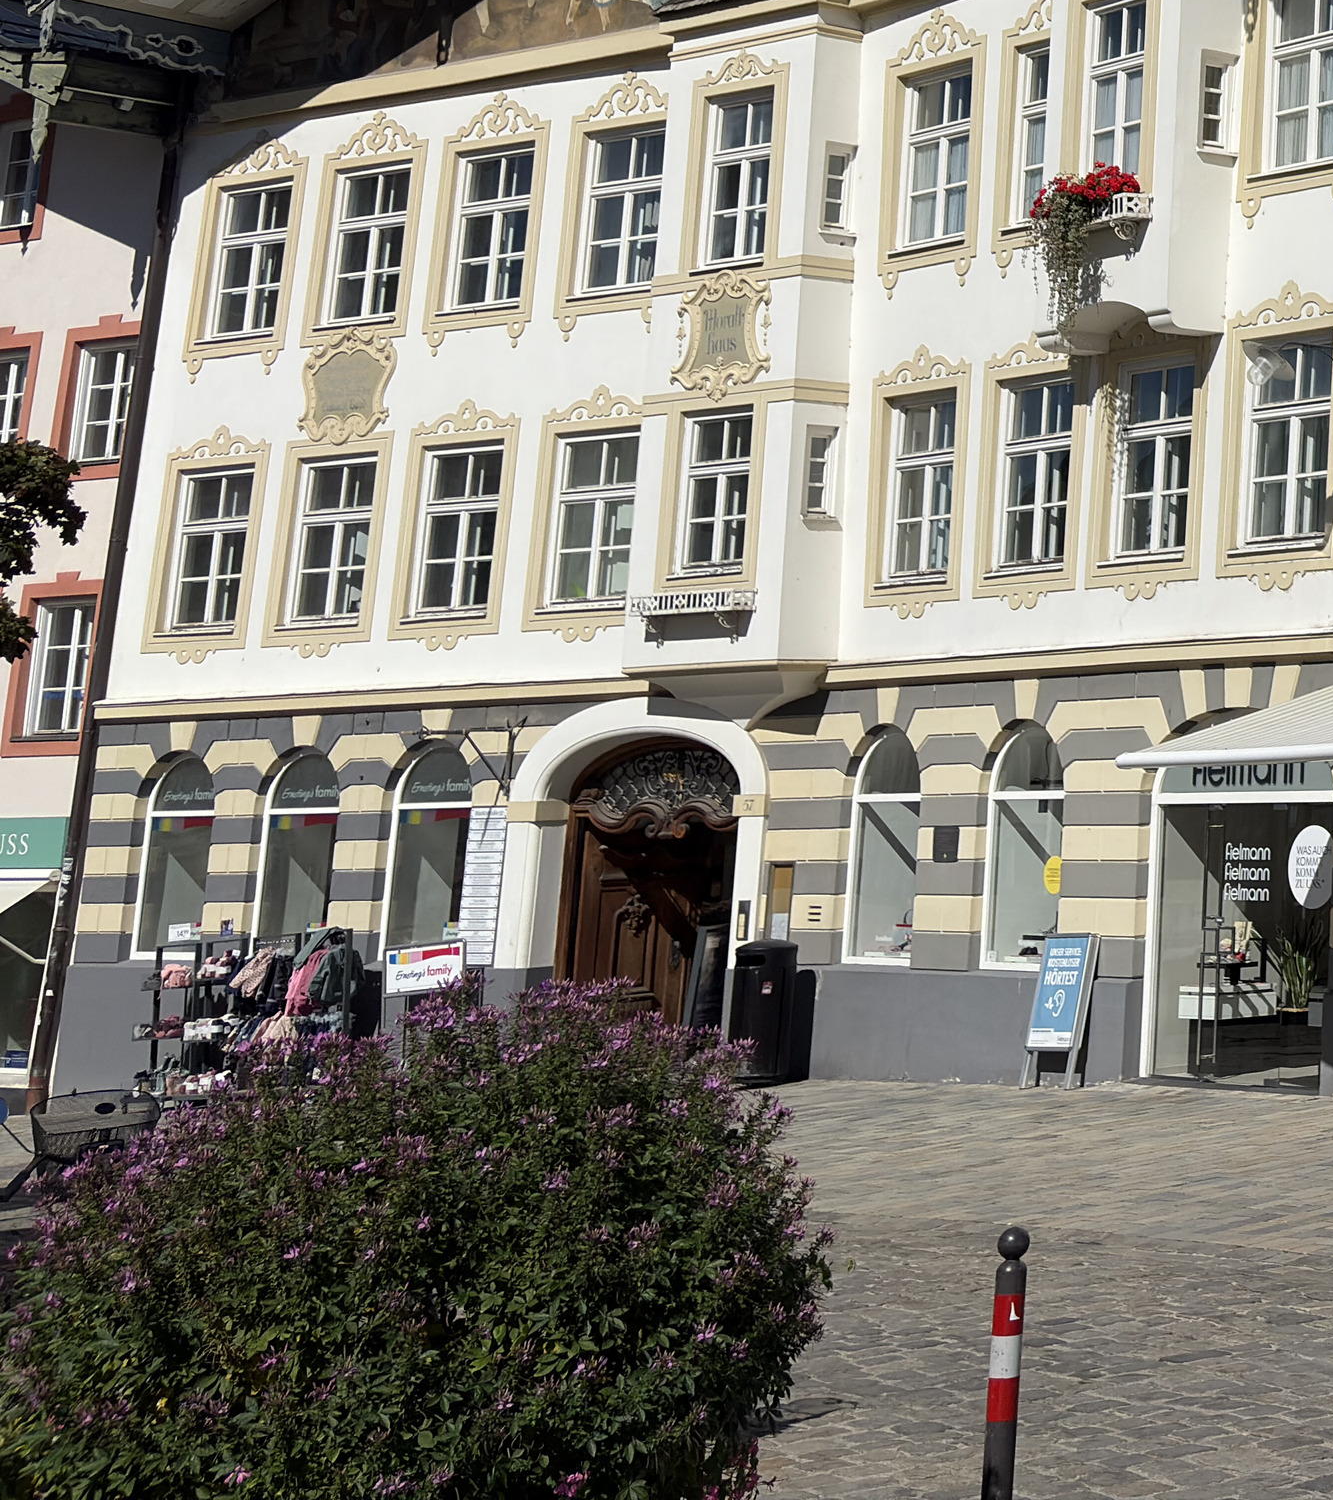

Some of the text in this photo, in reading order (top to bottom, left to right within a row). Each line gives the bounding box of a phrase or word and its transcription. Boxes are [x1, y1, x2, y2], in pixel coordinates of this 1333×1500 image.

[194, 787, 215, 801] famil
[1225, 842, 1271, 861] fielmann
[1296, 845, 1312, 855] WAS
[1224, 862, 1270, 881] fielmann
[1223, 882, 1270, 902] fielmann
[427, 964, 453, 977] family
[1044, 968, 1078, 985] HÖRTEST
